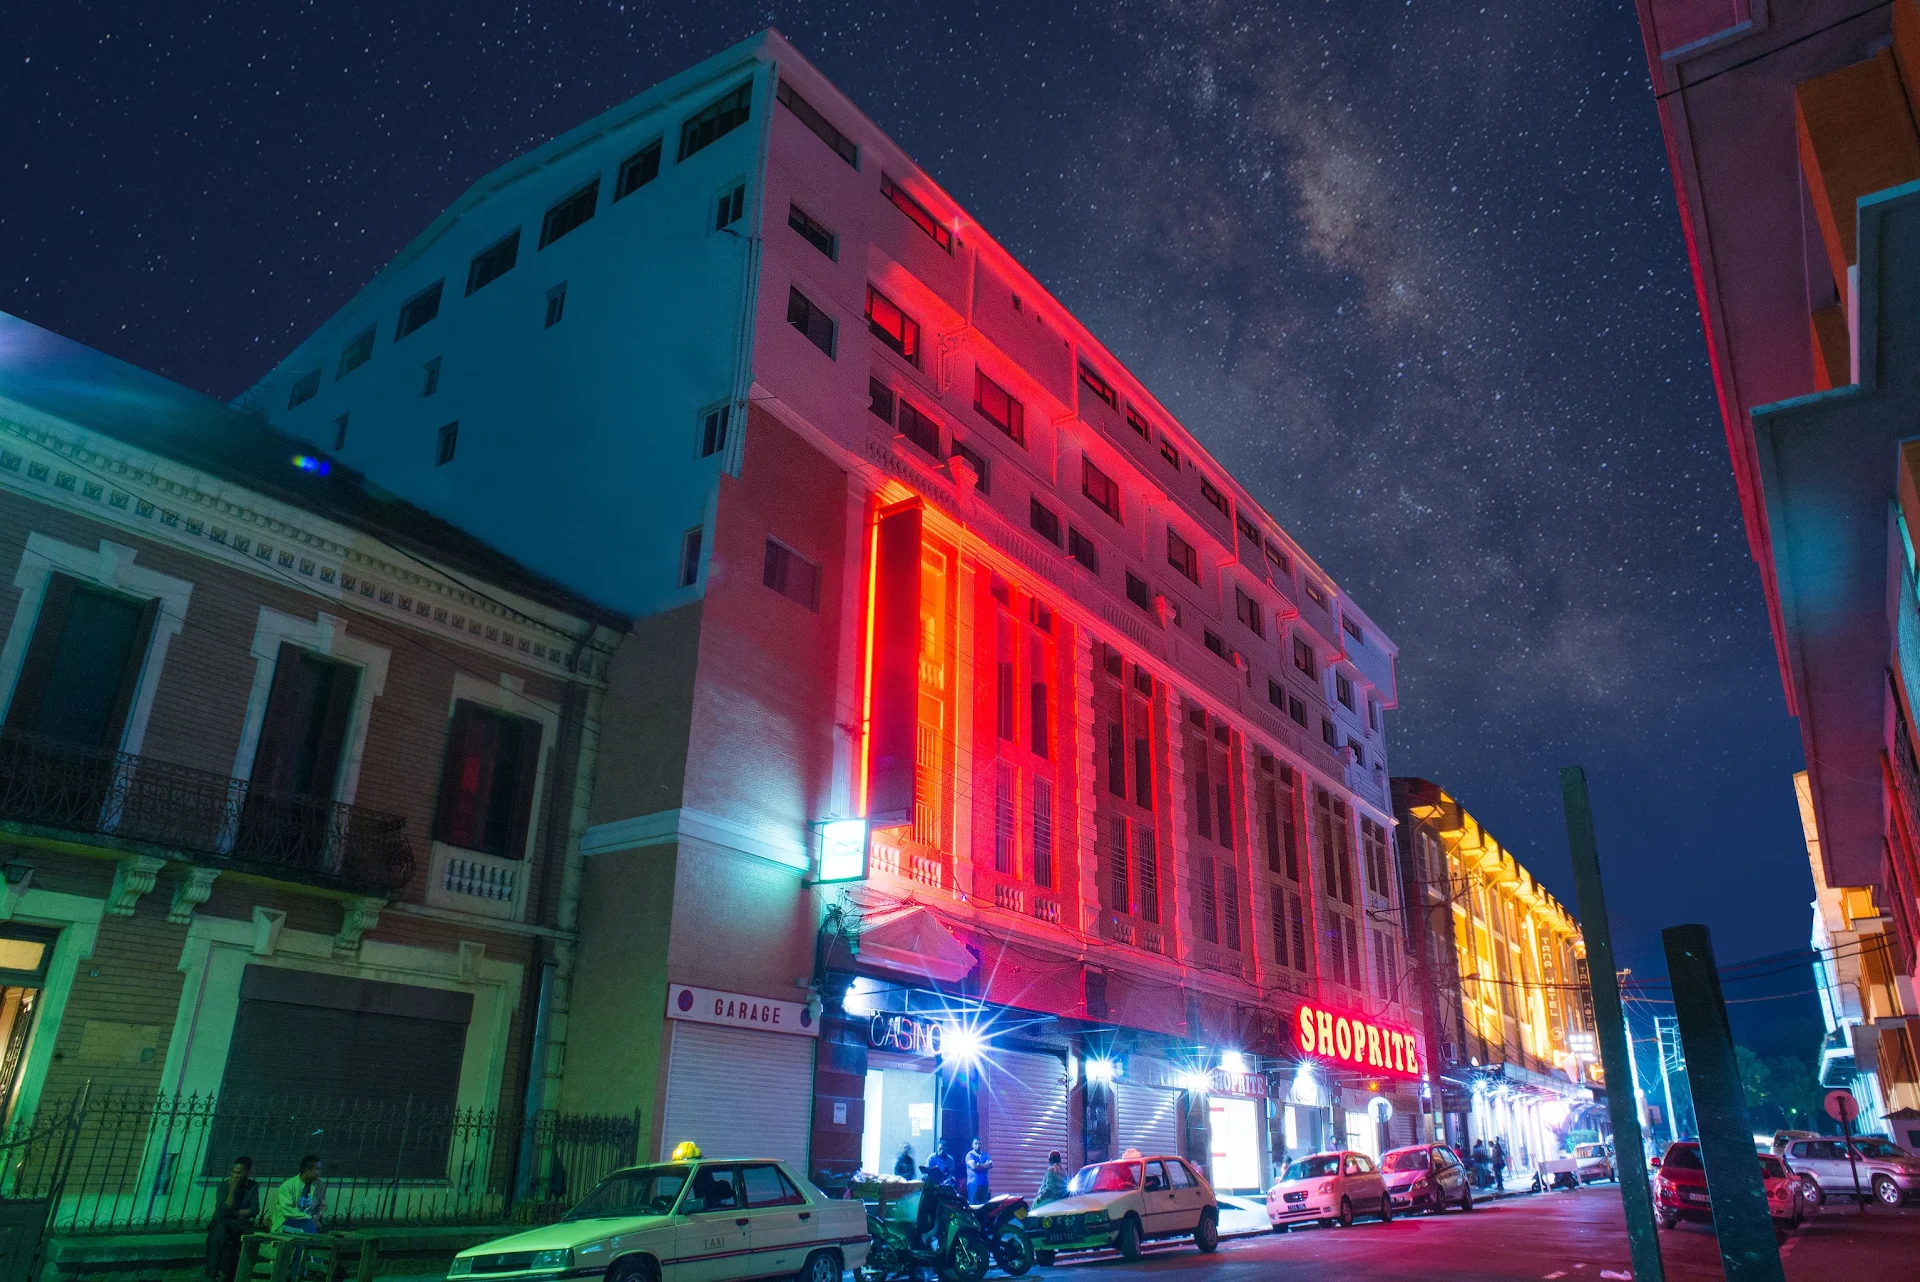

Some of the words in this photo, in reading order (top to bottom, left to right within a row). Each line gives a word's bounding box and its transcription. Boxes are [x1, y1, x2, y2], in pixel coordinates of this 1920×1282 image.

[1541, 937, 1553, 968] TANA
[714, 998, 781, 1024] GARAGE
[1545, 977, 1558, 1017] HOTEL
[1584, 1002, 1594, 1029] HOTE
[871, 1014, 943, 1055] CASINO
[1300, 1006, 1418, 1074] SHOPRITE
[703, 1236, 725, 1250] TAXI
